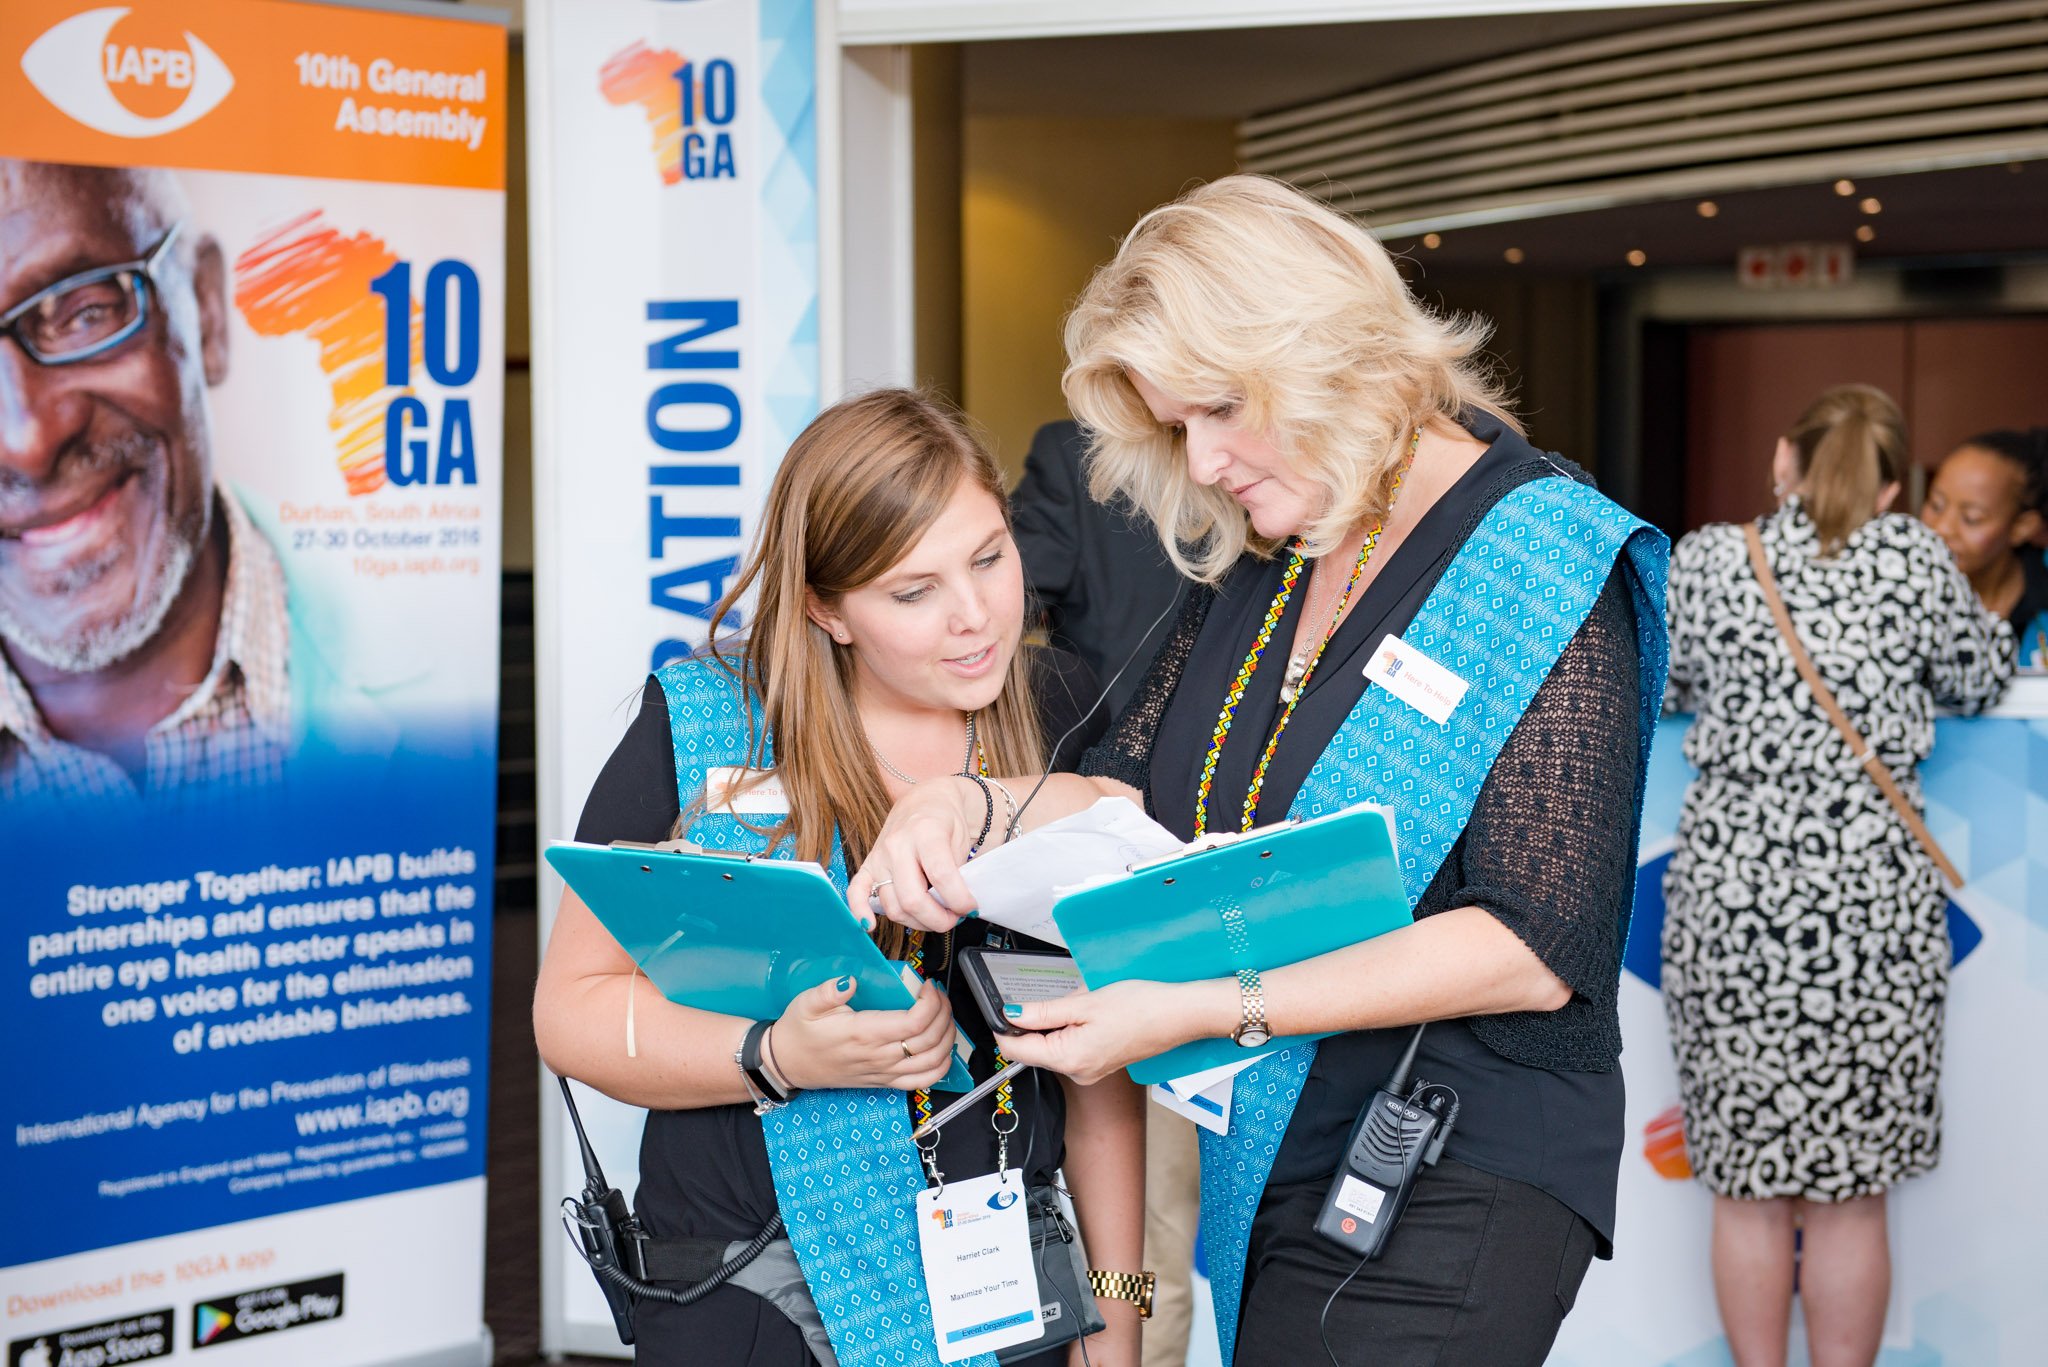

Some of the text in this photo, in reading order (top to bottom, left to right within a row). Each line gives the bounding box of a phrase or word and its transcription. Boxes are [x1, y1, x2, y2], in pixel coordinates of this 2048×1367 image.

[105, 44, 193, 89] IAPB
[295, 52, 486, 102] 10th General
[672, 59, 736, 126] 10
[335, 97, 486, 151] Assembly
[682, 133, 736, 179] GA
[370, 259, 481, 387] 10
[384, 396, 478, 487] GA
[279, 502, 481, 524] Durban, South Africa
[293, 525, 480, 549] 27-30 October 2016
[353, 556, 481, 581] 10ga.iapb.org
[1386, 667, 1397, 678] GA
[1391, 658, 1404, 671] 10
[1404, 671, 1452, 707] Here To Help
[67, 846, 476, 916] Stronger Together: IAPB builds
[28, 882, 476, 967] partnerships and ensures that the
[30, 916, 475, 999] entire eye health sector speaks in
[102, 953, 474, 1027] one voice for the elimination
[172, 991, 472, 1054] of avoidable blindness.
[16, 1056, 471, 1147] International Agency for the Prevention of Blindness
[295, 1086, 470, 1136] www.iapb.org
[1387, 1101, 1418, 1119] KENOOD
[943, 1209, 953, 1220] 10
[998, 1194, 1012, 1202] IAPB
[956, 1246, 1000, 1262] Harriet Clark
[7, 1275, 123, 1318] Download
[130, 1269, 165, 1290] the
[236, 1248, 276, 1271] app
[950, 1279, 1018, 1301] Maximize Your Time
[59, 1314, 164, 1348] Download on the
[235, 1293, 340, 1333] Google Play
[962, 1316, 1021, 1337] Event Organisers
[105, 1332, 165, 1364] Store
